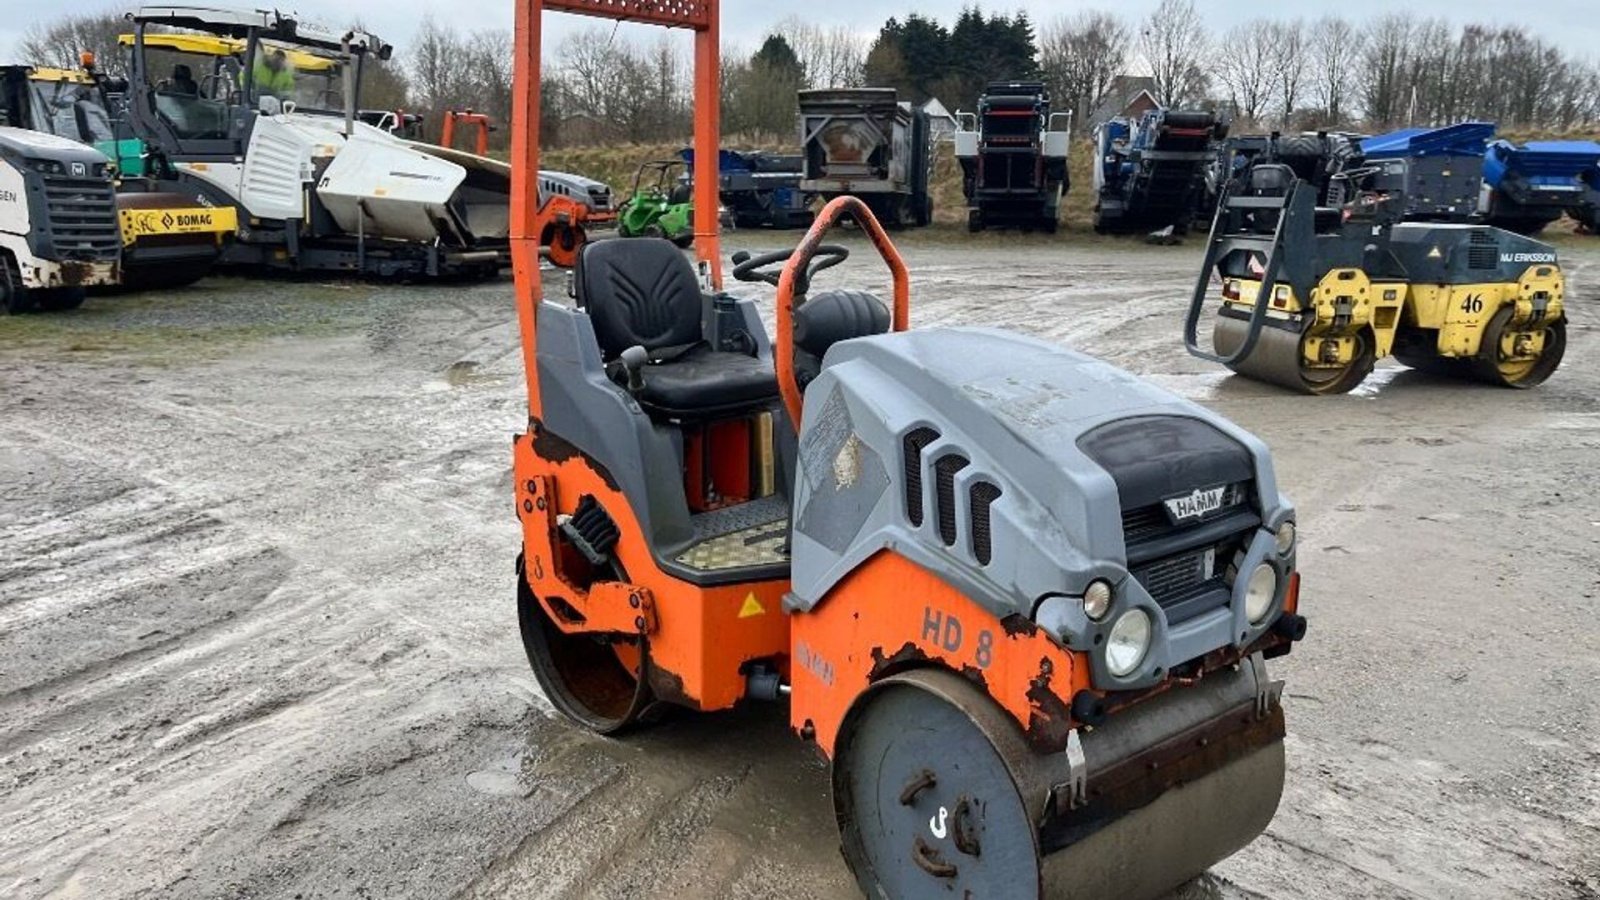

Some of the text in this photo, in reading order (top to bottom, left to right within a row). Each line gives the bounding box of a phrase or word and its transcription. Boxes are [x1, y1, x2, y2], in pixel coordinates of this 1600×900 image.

[176, 214, 212, 226] BOMAG
[1461, 293, 1483, 313] 46
[1176, 491, 1219, 517] HAMM
[922, 606, 993, 668] HD 8
